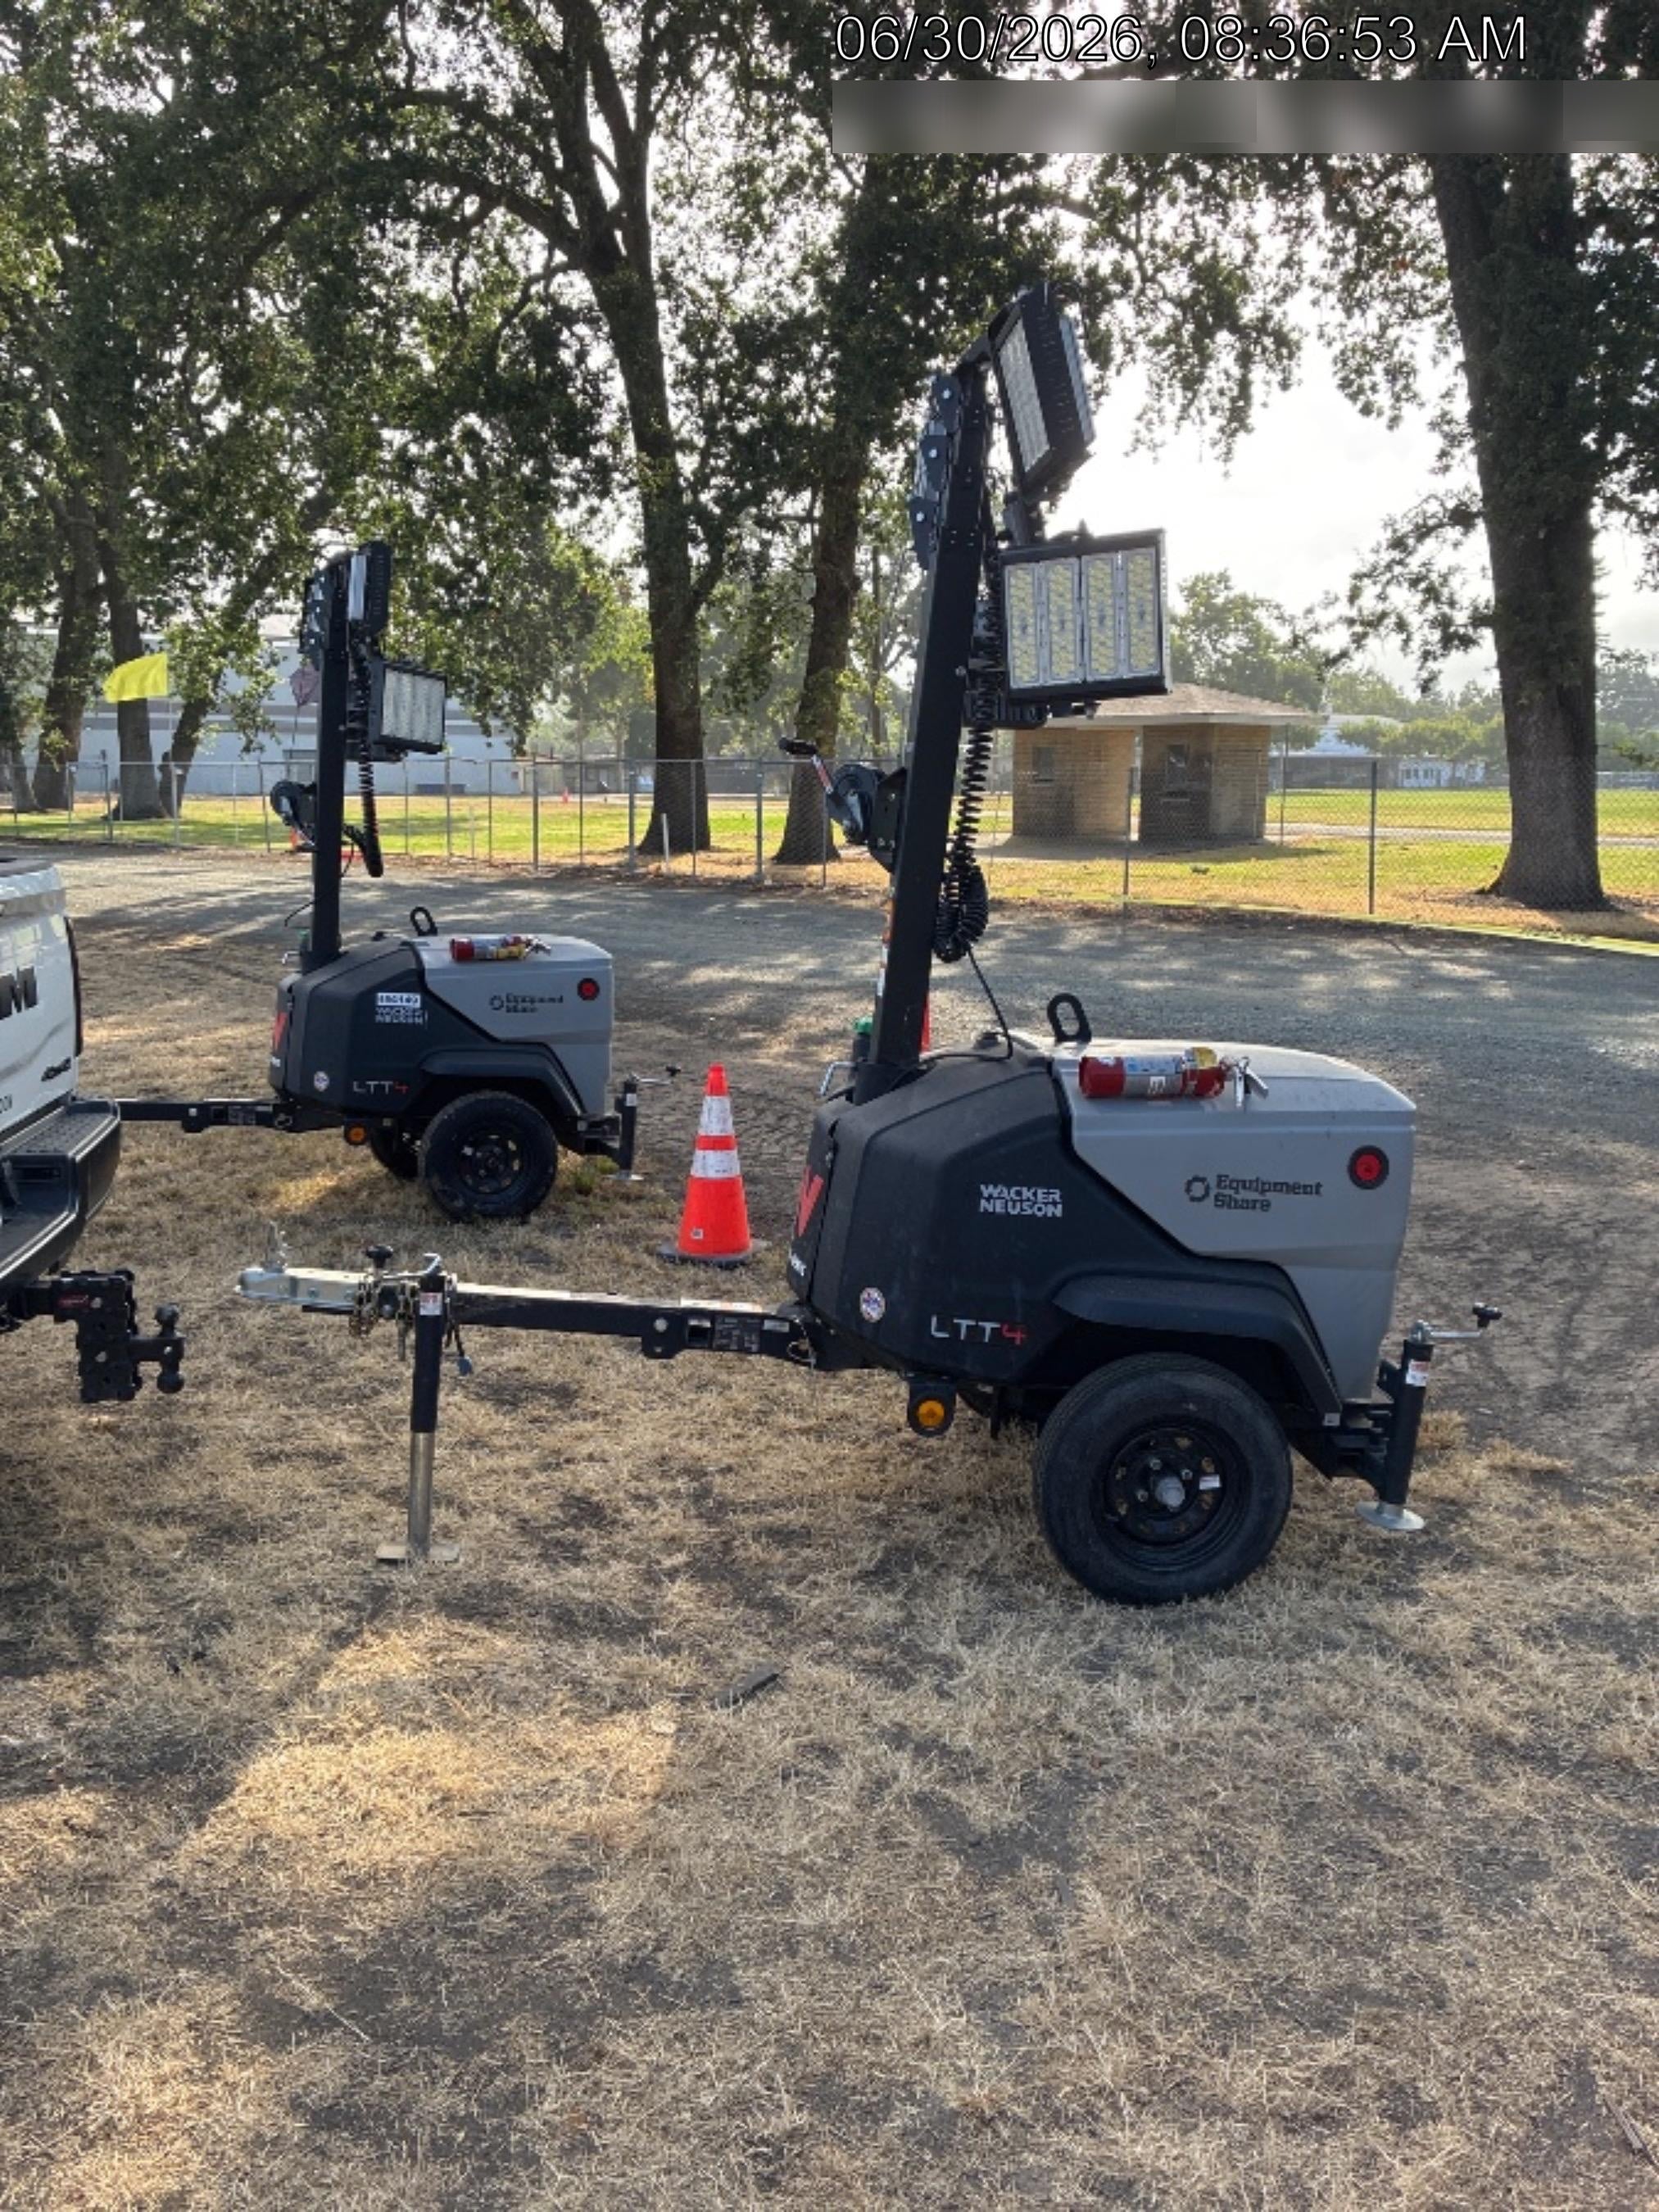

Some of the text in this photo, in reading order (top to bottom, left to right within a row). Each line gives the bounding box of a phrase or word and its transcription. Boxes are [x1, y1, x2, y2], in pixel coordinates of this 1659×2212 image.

[353, 1081, 409, 1095] LTT4
[980, 1184, 1062, 1203] WACKER
[1217, 1174, 1323, 1196] Equipment
[980, 1199, 1063, 1217] NEUSON
[1213, 1192, 1271, 1213] Share
[931, 1314, 1027, 1345] LTT4
